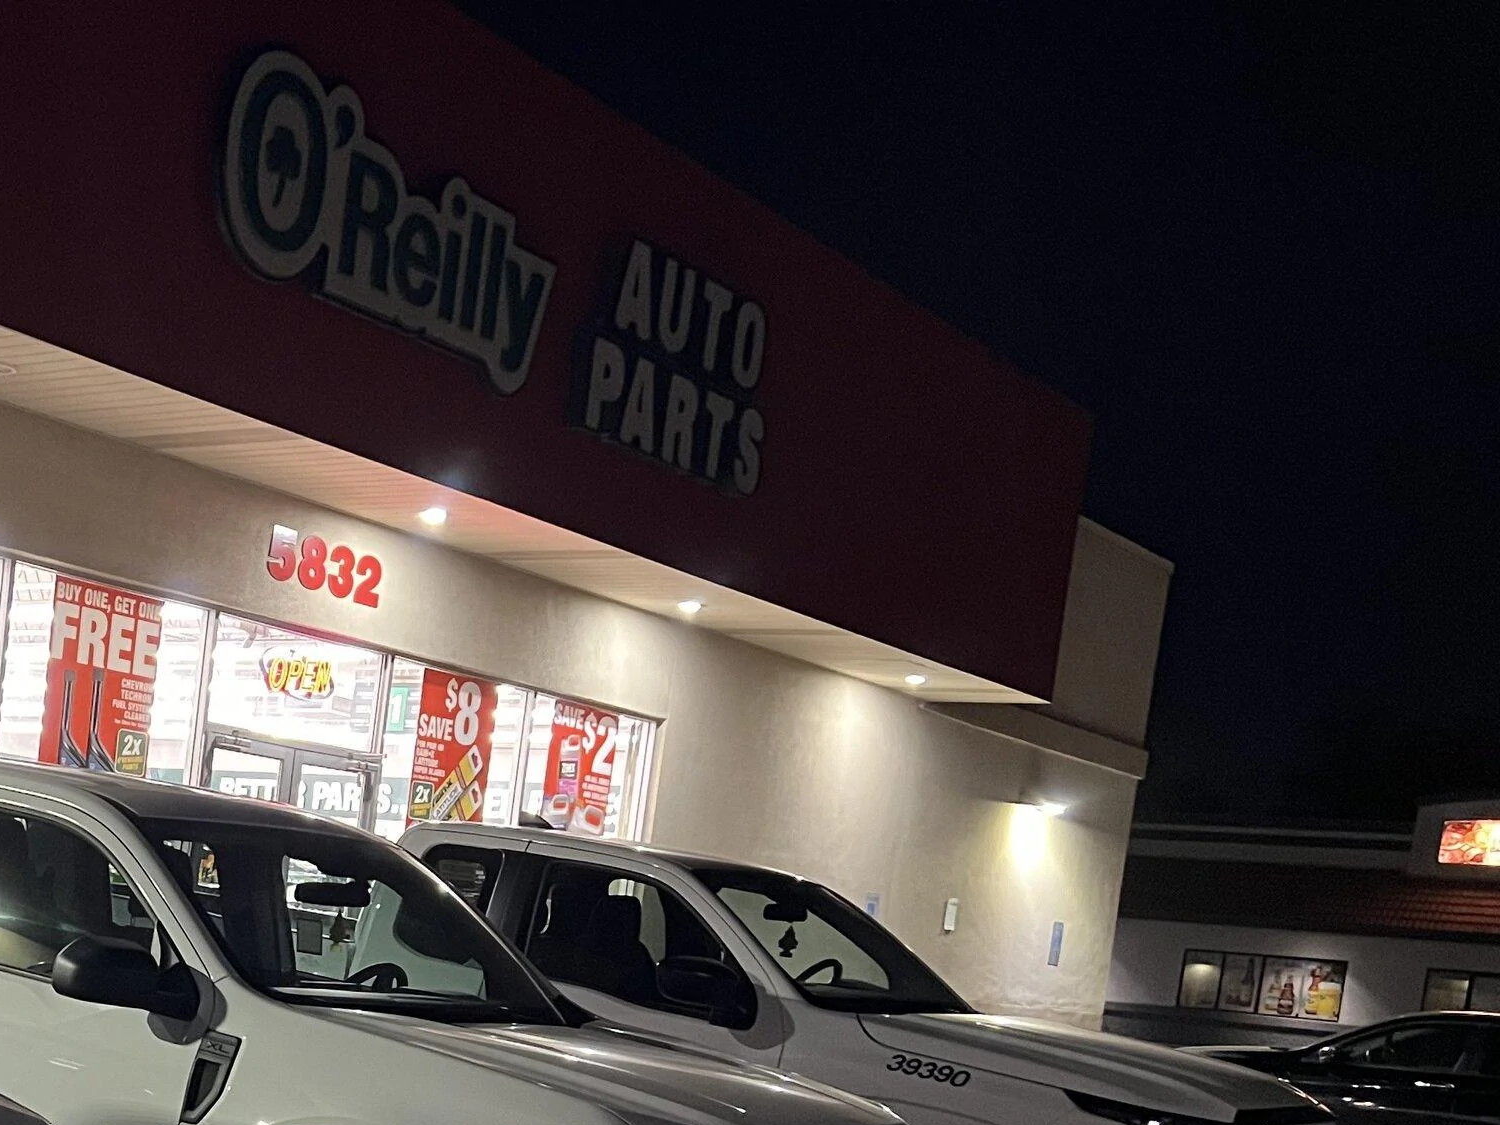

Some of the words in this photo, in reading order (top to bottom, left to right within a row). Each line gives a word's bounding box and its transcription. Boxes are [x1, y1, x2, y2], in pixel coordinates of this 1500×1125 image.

[239, 69, 545, 372] O'Reilly
[615, 239, 767, 388] AUTO
[585, 336, 765, 496] PARTS
[56, 581, 82, 604] BUY
[84, 588, 111, 613] ONE,
[114, 595, 136, 615] GET
[266, 524, 382, 609] 5832
[51, 600, 161, 679] FREE
[268, 656, 332, 693] OPEN
[418, 713, 453, 741] SAVE
[445, 678, 482, 746] $8
[553, 703, 586, 731] SAVE
[582, 712, 618, 776] $2
[207, 1040, 230, 1054] XL
[886, 1054, 971, 1087] 39390
